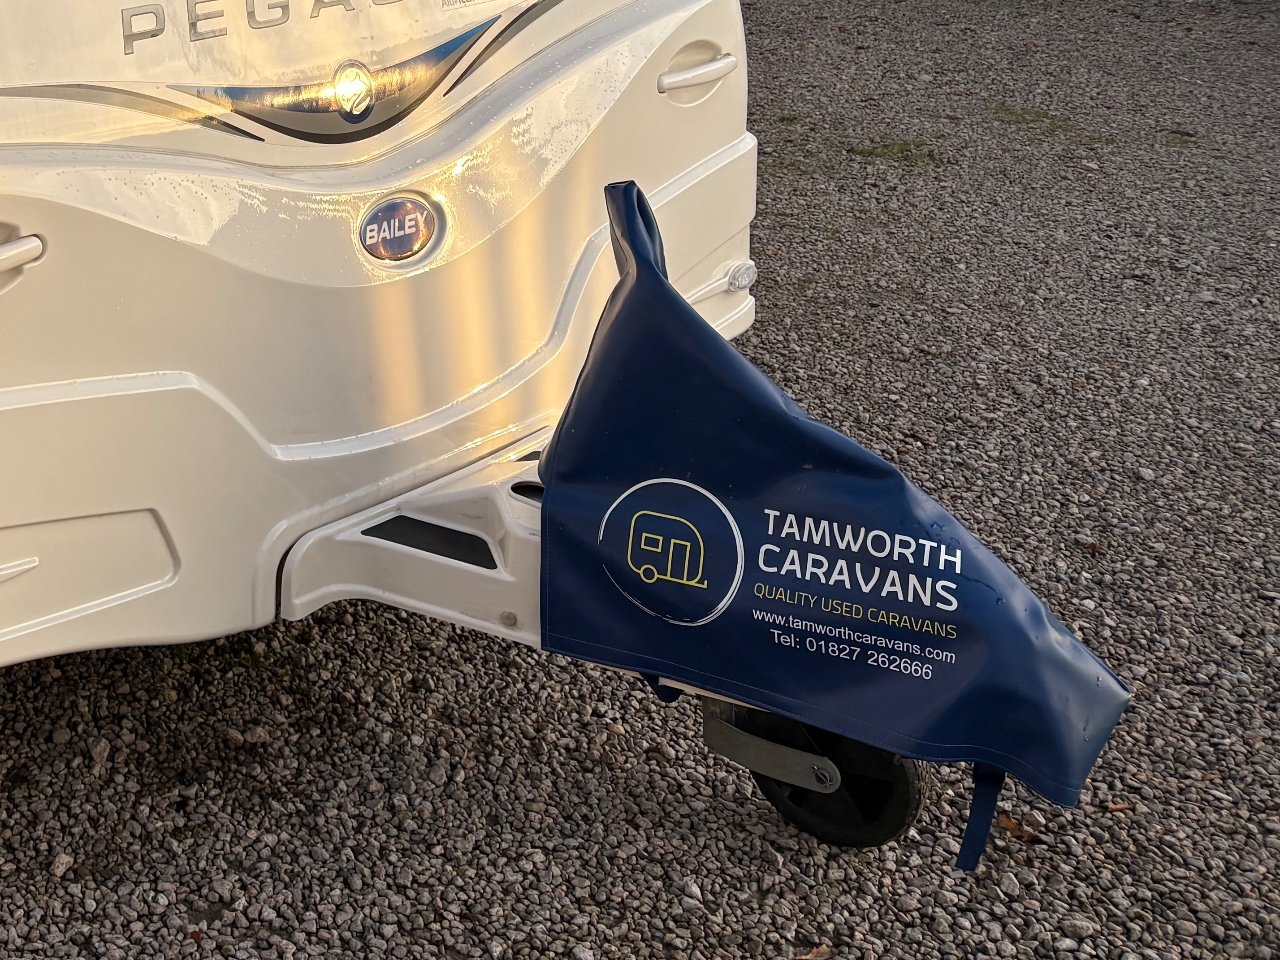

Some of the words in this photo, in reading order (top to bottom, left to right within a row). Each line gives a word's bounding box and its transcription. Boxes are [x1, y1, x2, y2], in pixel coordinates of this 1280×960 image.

[365, 211, 428, 246] BAILEY
[763, 508, 962, 574] TAMWORTH
[758, 543, 959, 612] CARAVANS
[752, 608, 956, 664] www.tamworthcaravans.com
[753, 582, 818, 608] QUALITY
[821, 597, 863, 619] USED
[867, 608, 957, 639] CARAVANS
[770, 628, 800, 649] Tel:
[806, 637, 861, 661] 01827
[867, 651, 933, 680] 262666
